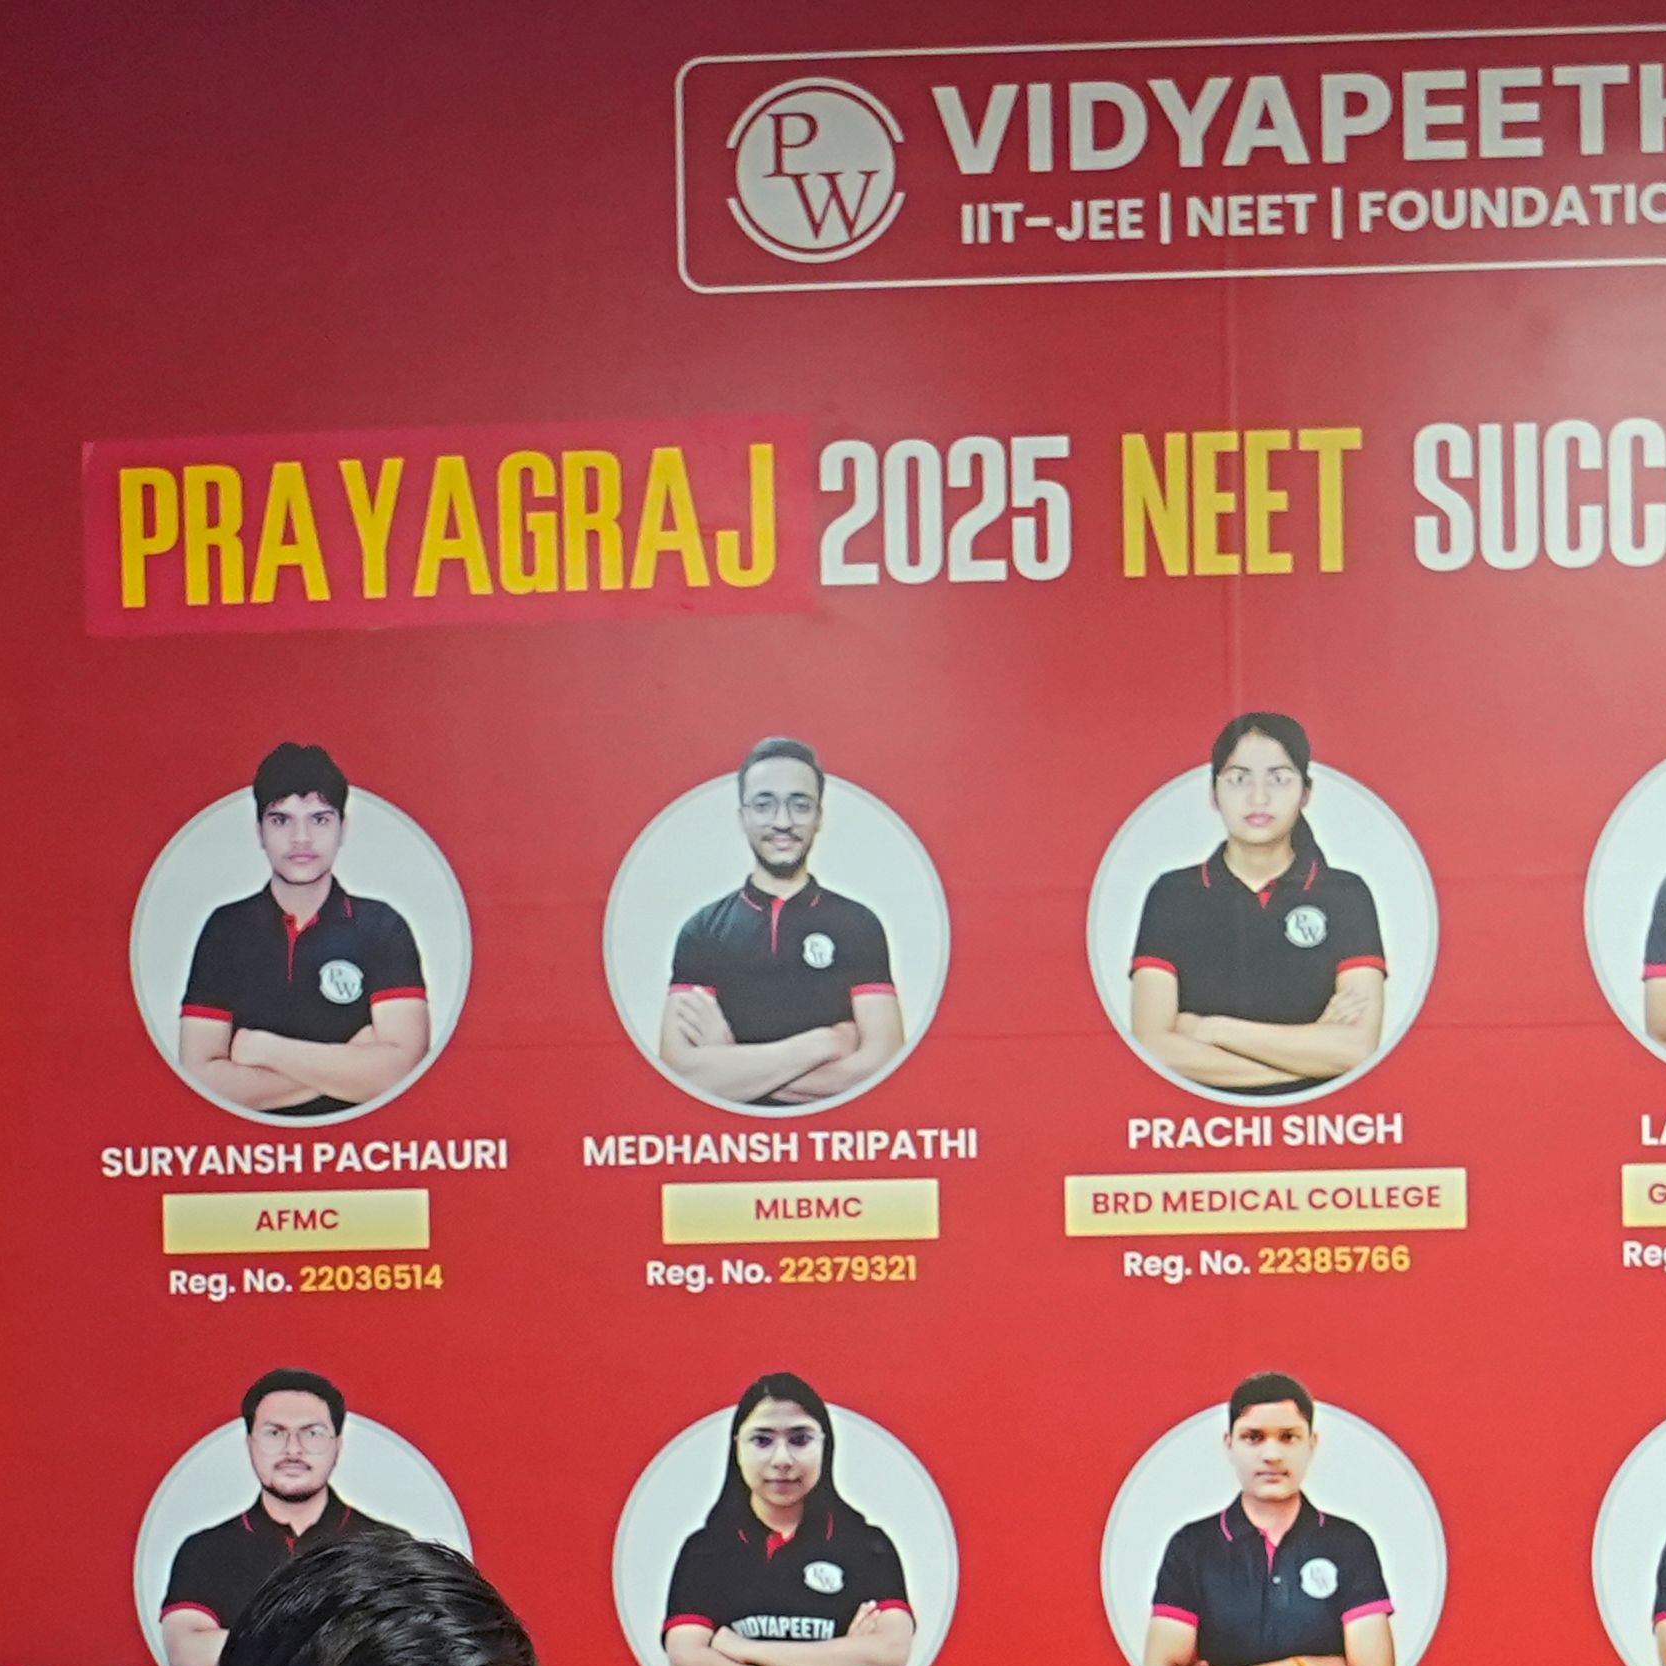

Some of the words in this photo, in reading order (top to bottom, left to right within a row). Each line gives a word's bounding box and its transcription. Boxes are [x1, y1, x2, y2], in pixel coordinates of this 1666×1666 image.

[768, 109, 883, 243] PW
[962, 199, 1144, 244] IIT-JEE
[1187, 194, 1317, 237] NEET
[121, 443, 776, 607] PRAYAGRAJ
[820, 436, 1071, 585] 2025
[1123, 427, 1362, 577] NEET
[584, 1132, 798, 1165] MEDHANSH
[808, 1129, 977, 1161] TRIPATHI
[1129, 1116, 1271, 1148] PRACHI
[1283, 1113, 1402, 1145] SINGH
[102, 1144, 302, 1177] SURYANSH
[314, 1139, 507, 1172] PACHAURI
[755, 1197, 861, 1220] MLBMC
[1093, 1192, 1153, 1214] BRD
[1163, 1189, 1298, 1212] MEDICAL
[1308, 1186, 1440, 1210] COLLEGE
[256, 1209, 338, 1231] AFMC
[170, 1270, 235, 1301] Reg.
[244, 1269, 292, 1292] No.
[301, 1264, 443, 1291] 22036514
[647, 1261, 713, 1293] Reg.
[722, 1260, 772, 1283] No.
[780, 1255, 916, 1282] 22379321
[1124, 1252, 1192, 1284] Reg.
[1200, 1250, 1250, 1275] No.
[1259, 1245, 1410, 1273] 22385766
